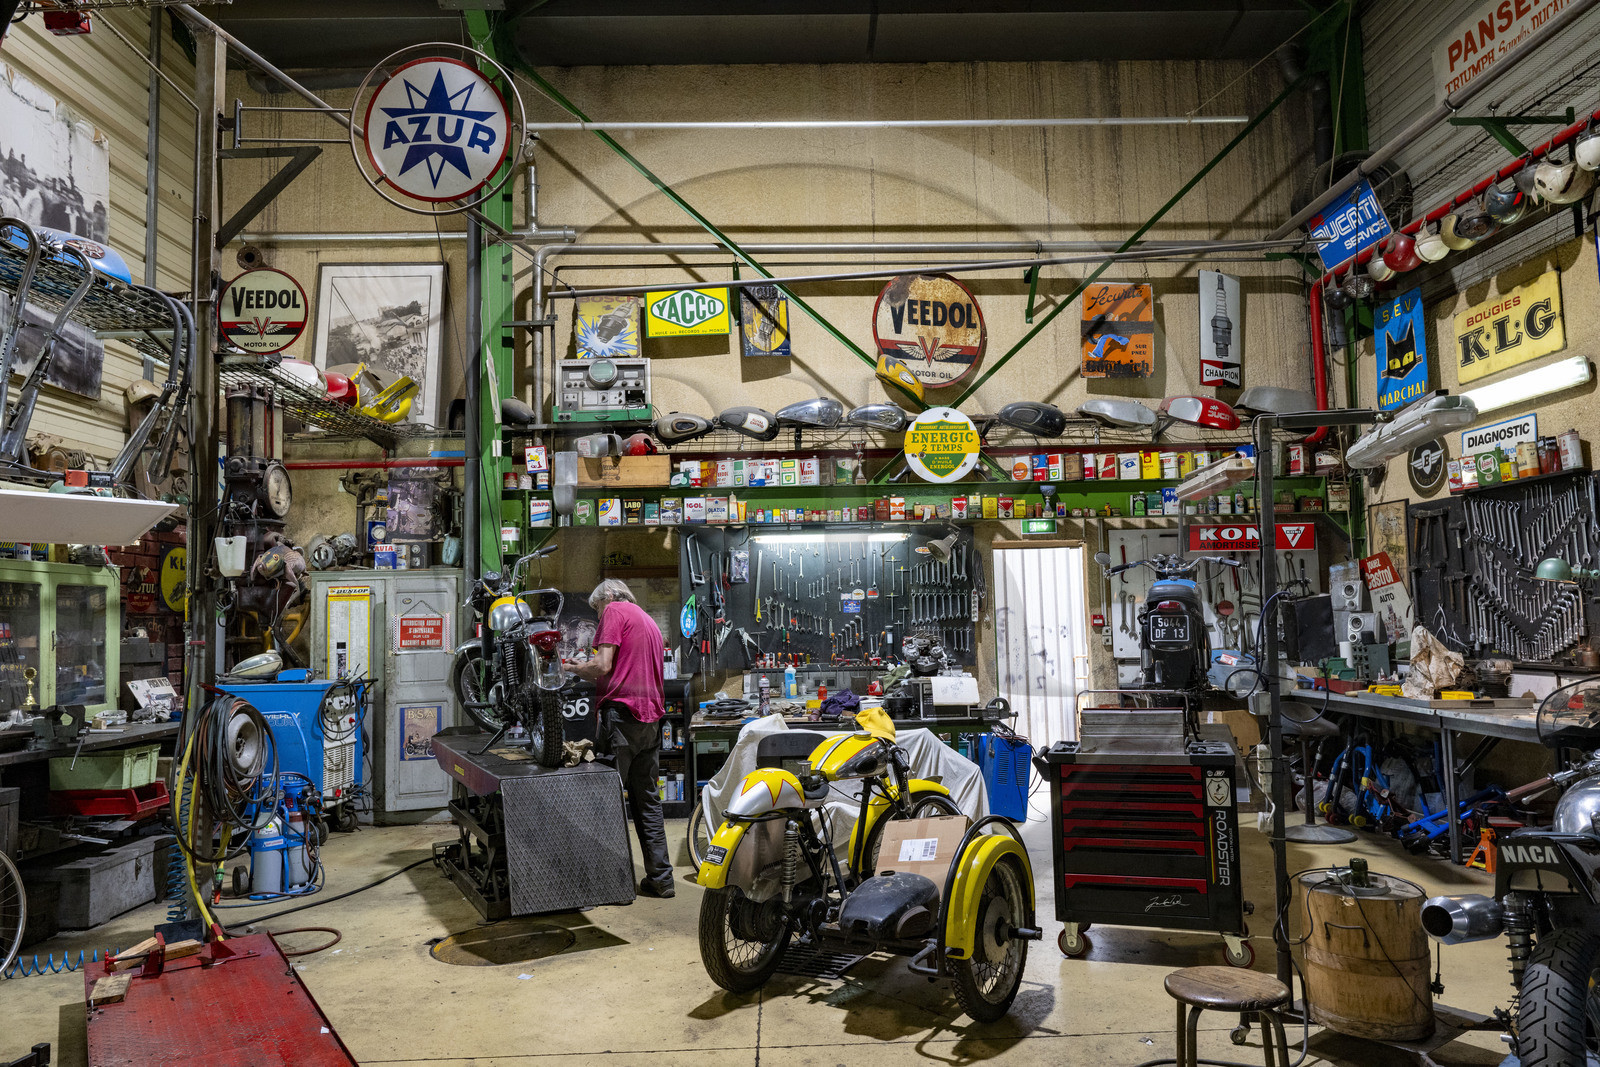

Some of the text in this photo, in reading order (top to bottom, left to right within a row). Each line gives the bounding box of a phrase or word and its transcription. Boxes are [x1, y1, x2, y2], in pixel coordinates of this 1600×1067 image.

[1444, 47, 1495, 95] TRIUMPH
[383, 116, 496, 154] AZUR
[1313, 194, 1378, 251] DUCATI
[1344, 218, 1387, 250] SERVICE
[231, 287, 300, 317] VEEDOL
[656, 292, 716, 324] YACCO
[1466, 296, 1521, 327] BOUGIES
[890, 298, 977, 334] VEEDOL
[1205, 368, 1239, 380] CHAMPION
[1379, 380, 1426, 408] MARCHAL
[911, 432, 973, 443] ENERGIC
[1467, 422, 1530, 449] DIAGNOSTIC
[922, 444, 963, 452] 2 TEMPS
[624, 501, 641, 509] LABO
[1199, 527, 1263, 541] KON
[1366, 558, 1381, 573] jouez
[1379, 592, 1395, 603] AUTO
[1155, 628, 1184, 638] DF 13
[1157, 617, 1181, 628] 5044
[562, 697, 590, 718] 56
[1215, 810, 1231, 886] ROADSTER
[1501, 845, 1560, 864] NACA
